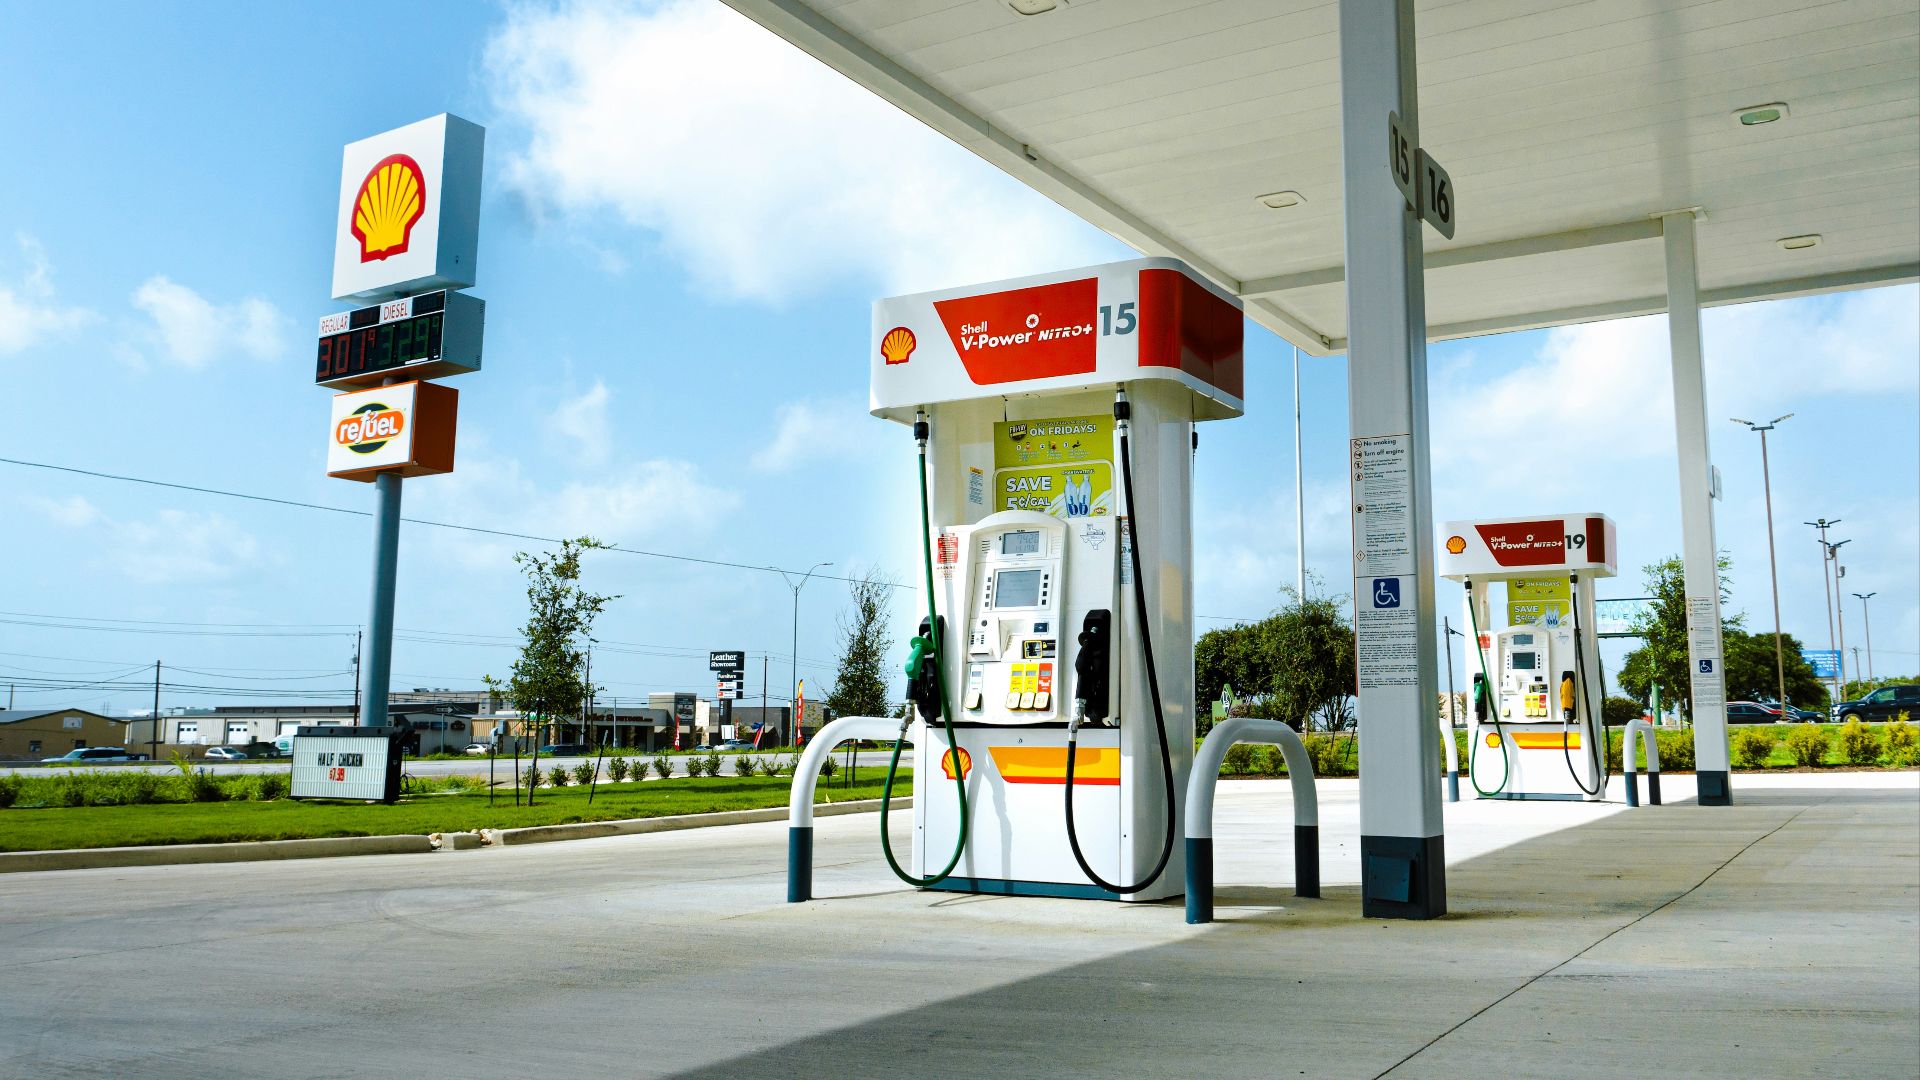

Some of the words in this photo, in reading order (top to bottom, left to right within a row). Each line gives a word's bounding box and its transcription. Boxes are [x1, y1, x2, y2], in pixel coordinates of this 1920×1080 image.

[1393, 124, 1410, 185] 15
[1428, 166, 1450, 223] 16
[383, 302, 408, 320] DIESEL
[321, 315, 348, 333] REGULAR
[961, 321, 988, 334] Shell
[1099, 302, 1137, 337] 15
[961, 332, 1033, 350] V-Power
[1030, 427, 1045, 437] ON
[1048, 424, 1096, 436] FRIDAYS!
[1006, 476, 1052, 492] SAVE
[1491, 542, 1530, 550] V-Power
[1565, 533, 1586, 549] 19
[1514, 605, 1539, 613] SAVE
[711, 653, 737, 661] Leather
[318, 753, 335, 766] HALF
[338, 753, 363, 767] CHICKEN
